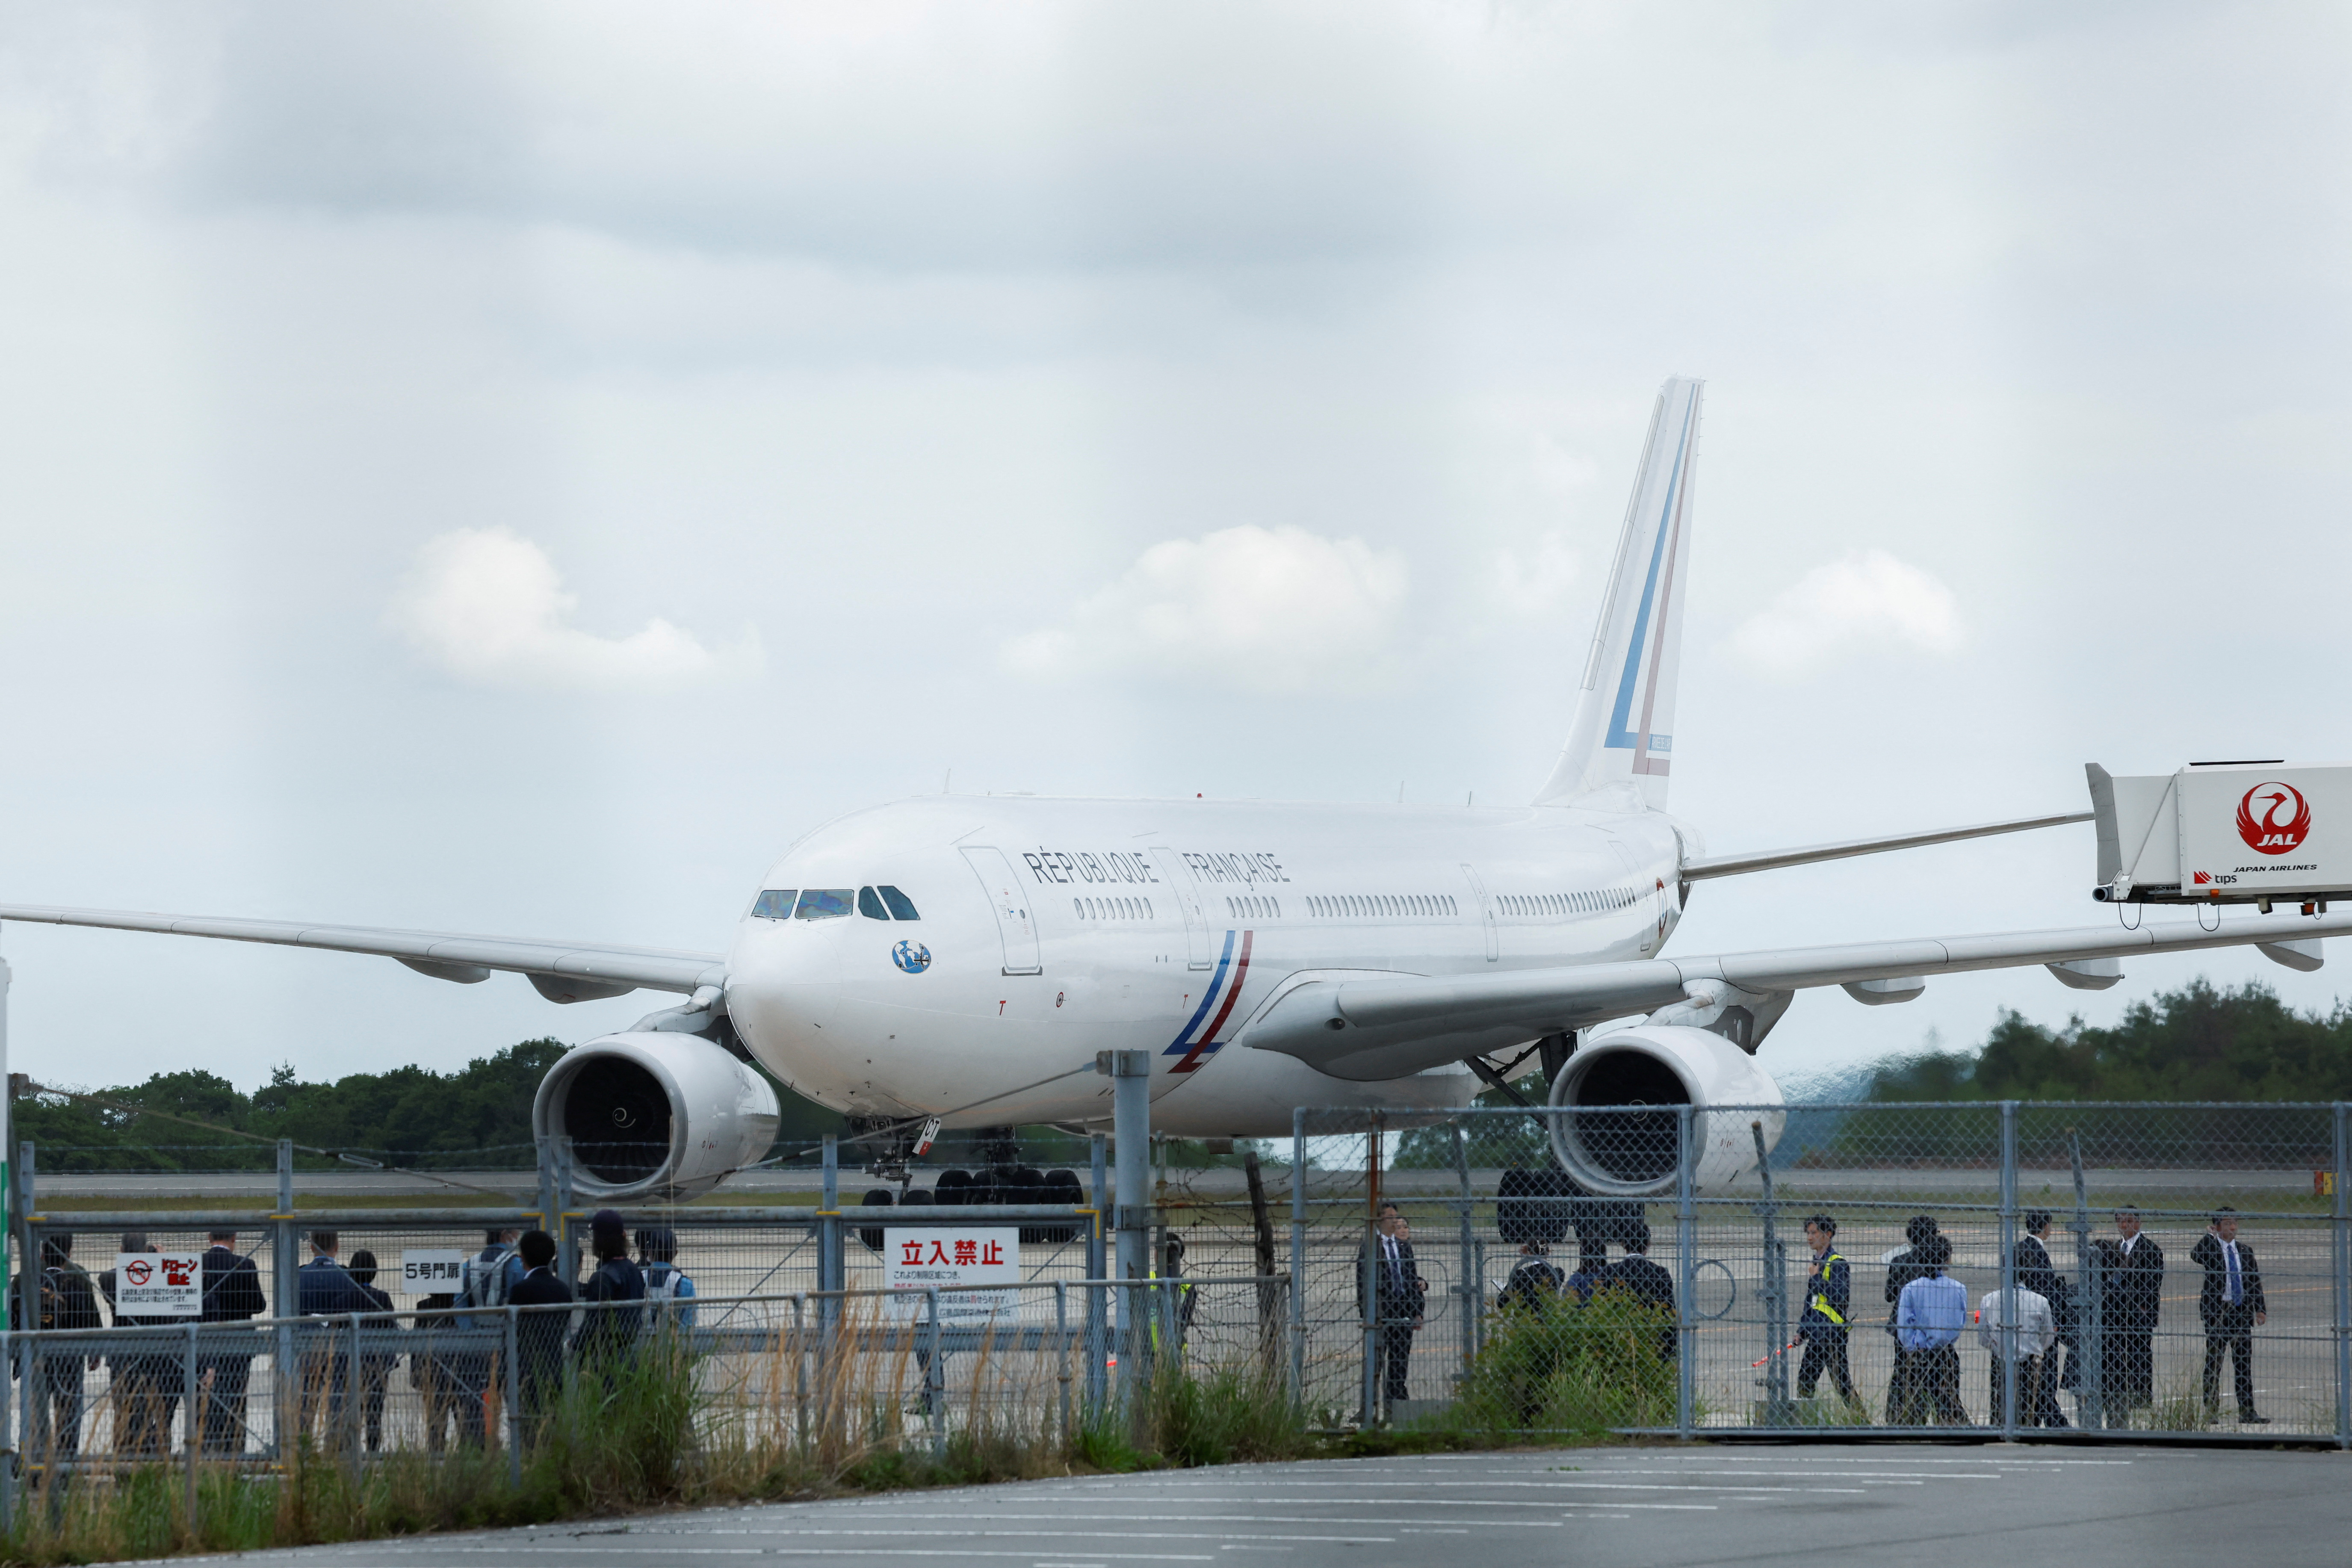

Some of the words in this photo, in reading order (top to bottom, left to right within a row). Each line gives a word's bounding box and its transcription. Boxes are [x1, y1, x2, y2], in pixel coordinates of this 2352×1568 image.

[2257, 834, 2297, 846] JAL
[1022, 846, 1159, 885] RÉPUBLIQUE
[1182, 853, 1291, 891] FRANÇAISE
[2215, 874, 2237, 884] tips
[925, 1119, 940, 1138] CT
[901, 1240, 1004, 1266] 立入禁止
[162, 1258, 198, 1273] ドローン
[406, 1263, 460, 1279] 5号門扉
